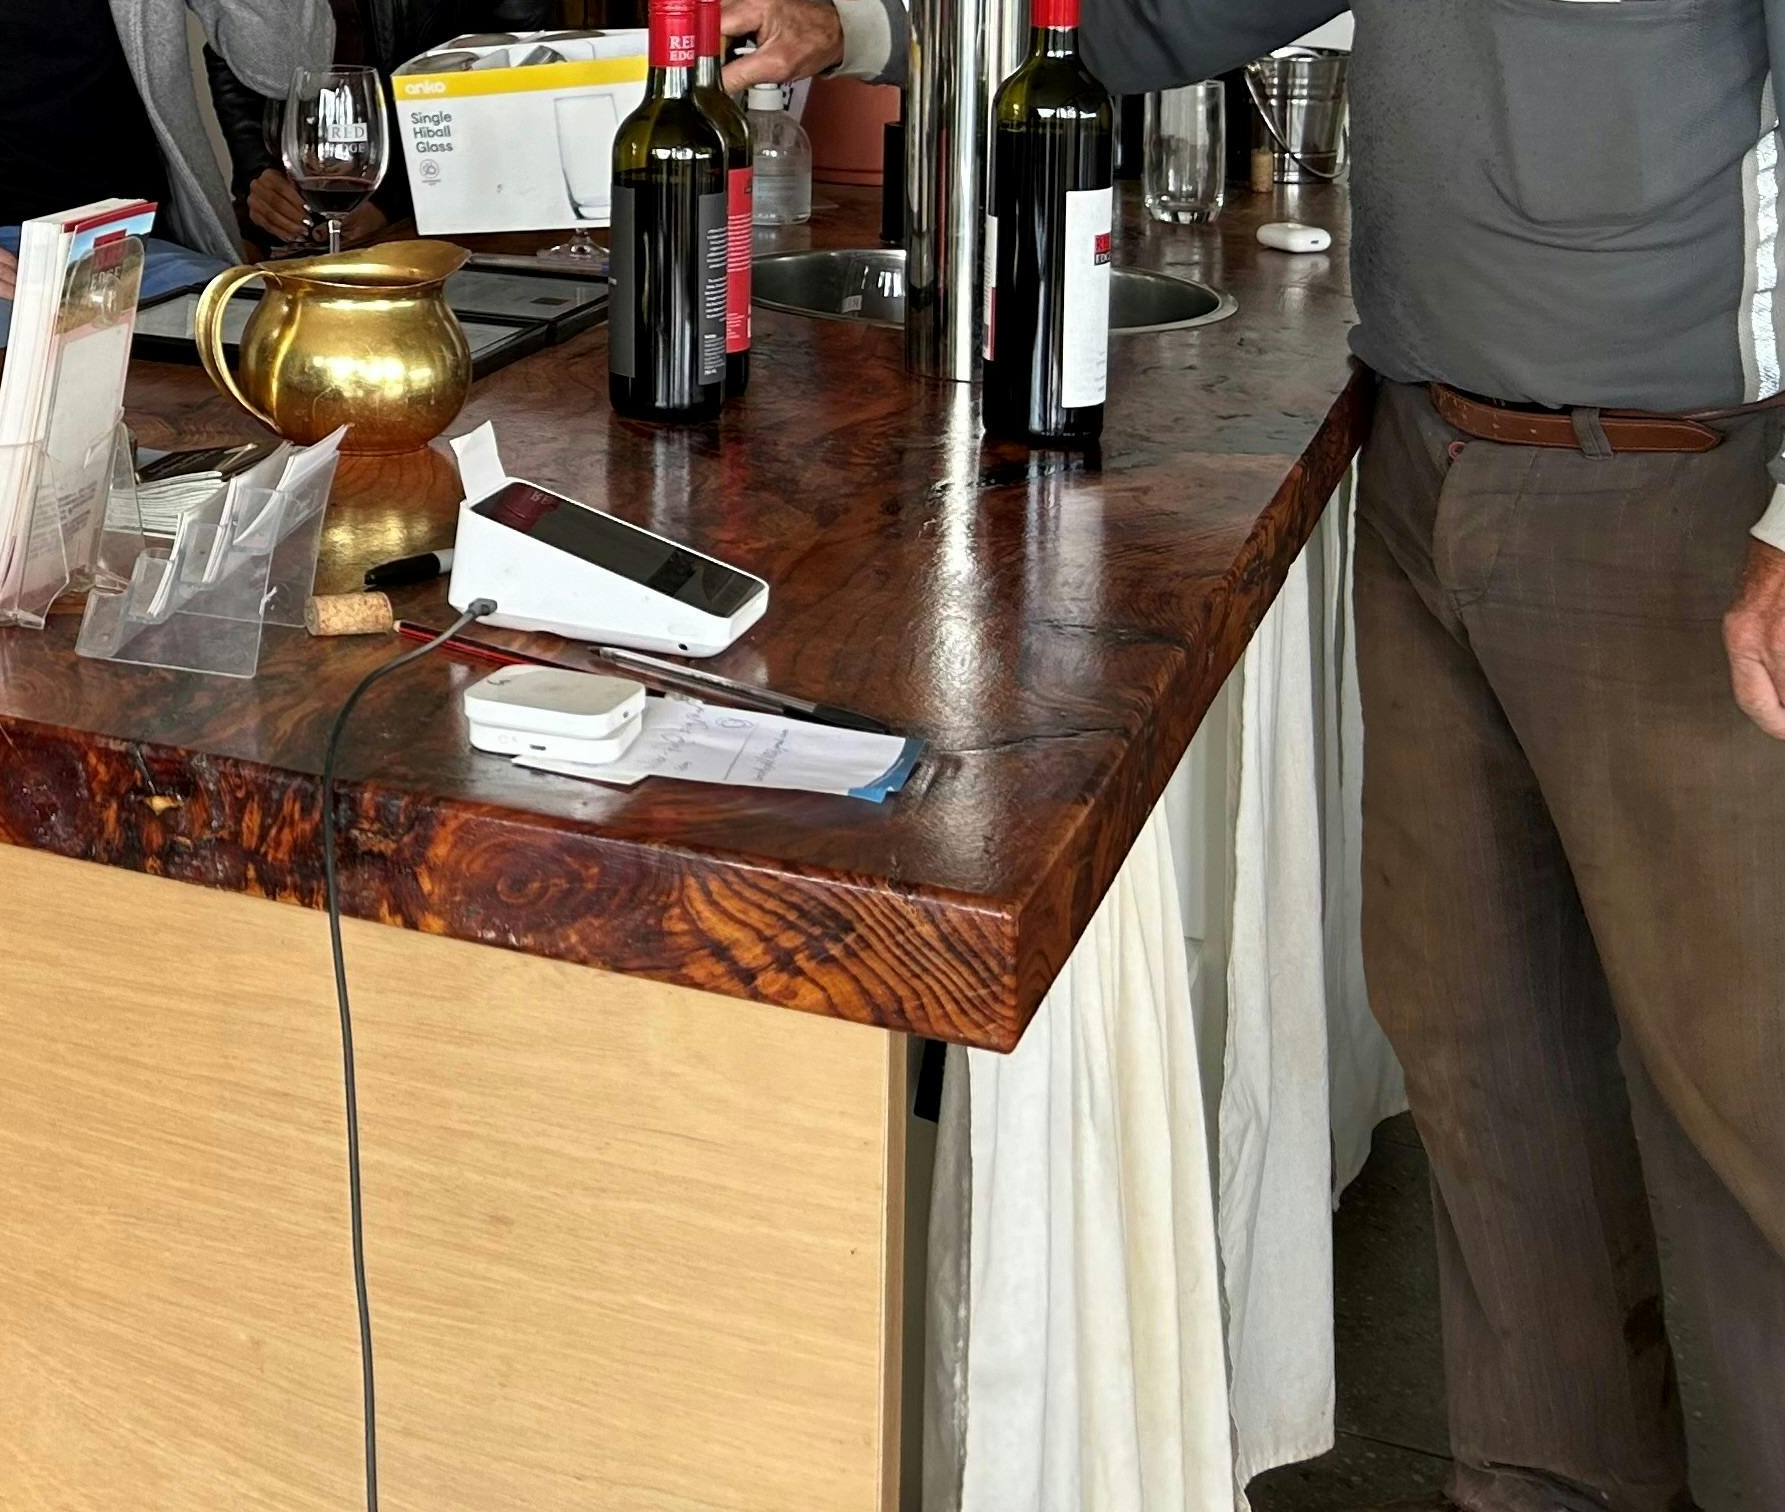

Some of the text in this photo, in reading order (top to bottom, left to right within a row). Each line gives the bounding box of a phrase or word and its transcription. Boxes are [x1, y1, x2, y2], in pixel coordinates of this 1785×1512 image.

[669, 49, 695, 62] EDG
[404, 79, 447, 95] anko
[410, 110, 453, 126] Single
[413, 125, 452, 139] Hiball
[416, 140, 454, 154] Glass
